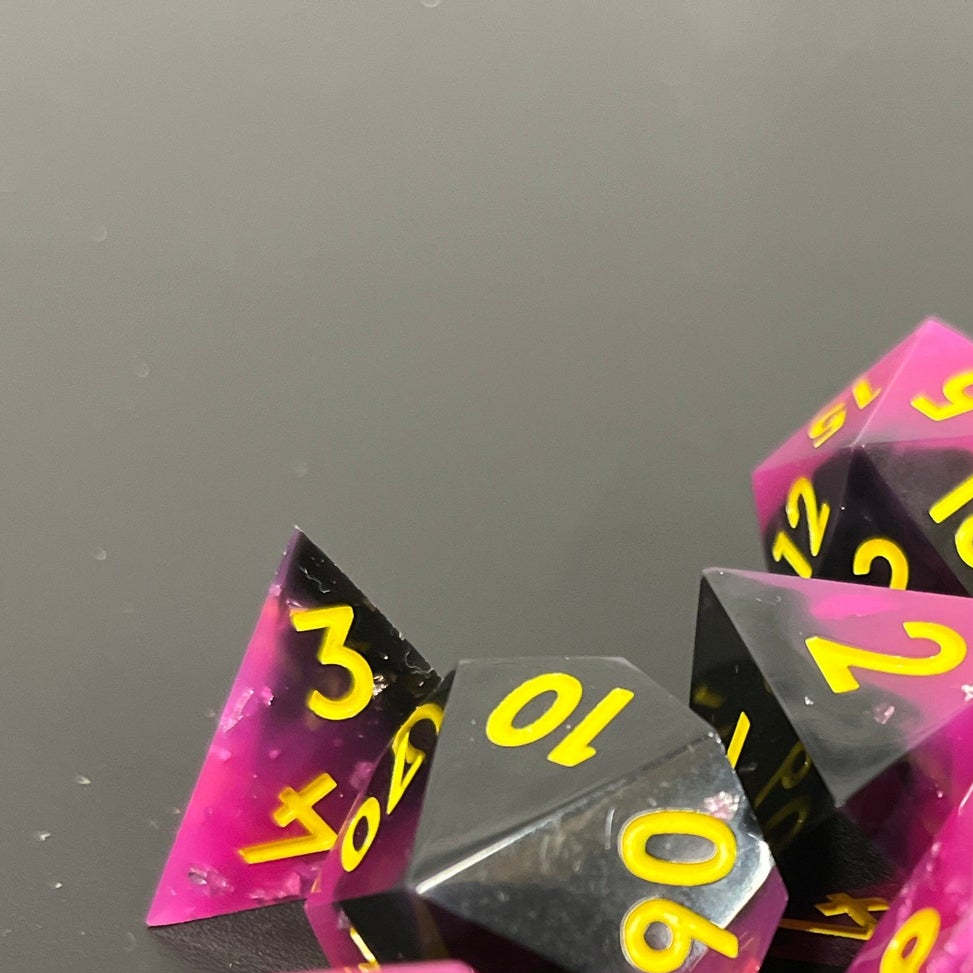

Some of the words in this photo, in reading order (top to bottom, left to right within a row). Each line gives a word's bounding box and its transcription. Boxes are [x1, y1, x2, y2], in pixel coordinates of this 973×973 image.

[771, 476, 831, 579] 12
[289, 604, 376, 721] 3
[805, 621, 968, 695] 2
[485, 672, 636, 768] 10
[238, 772, 340, 866] 4
